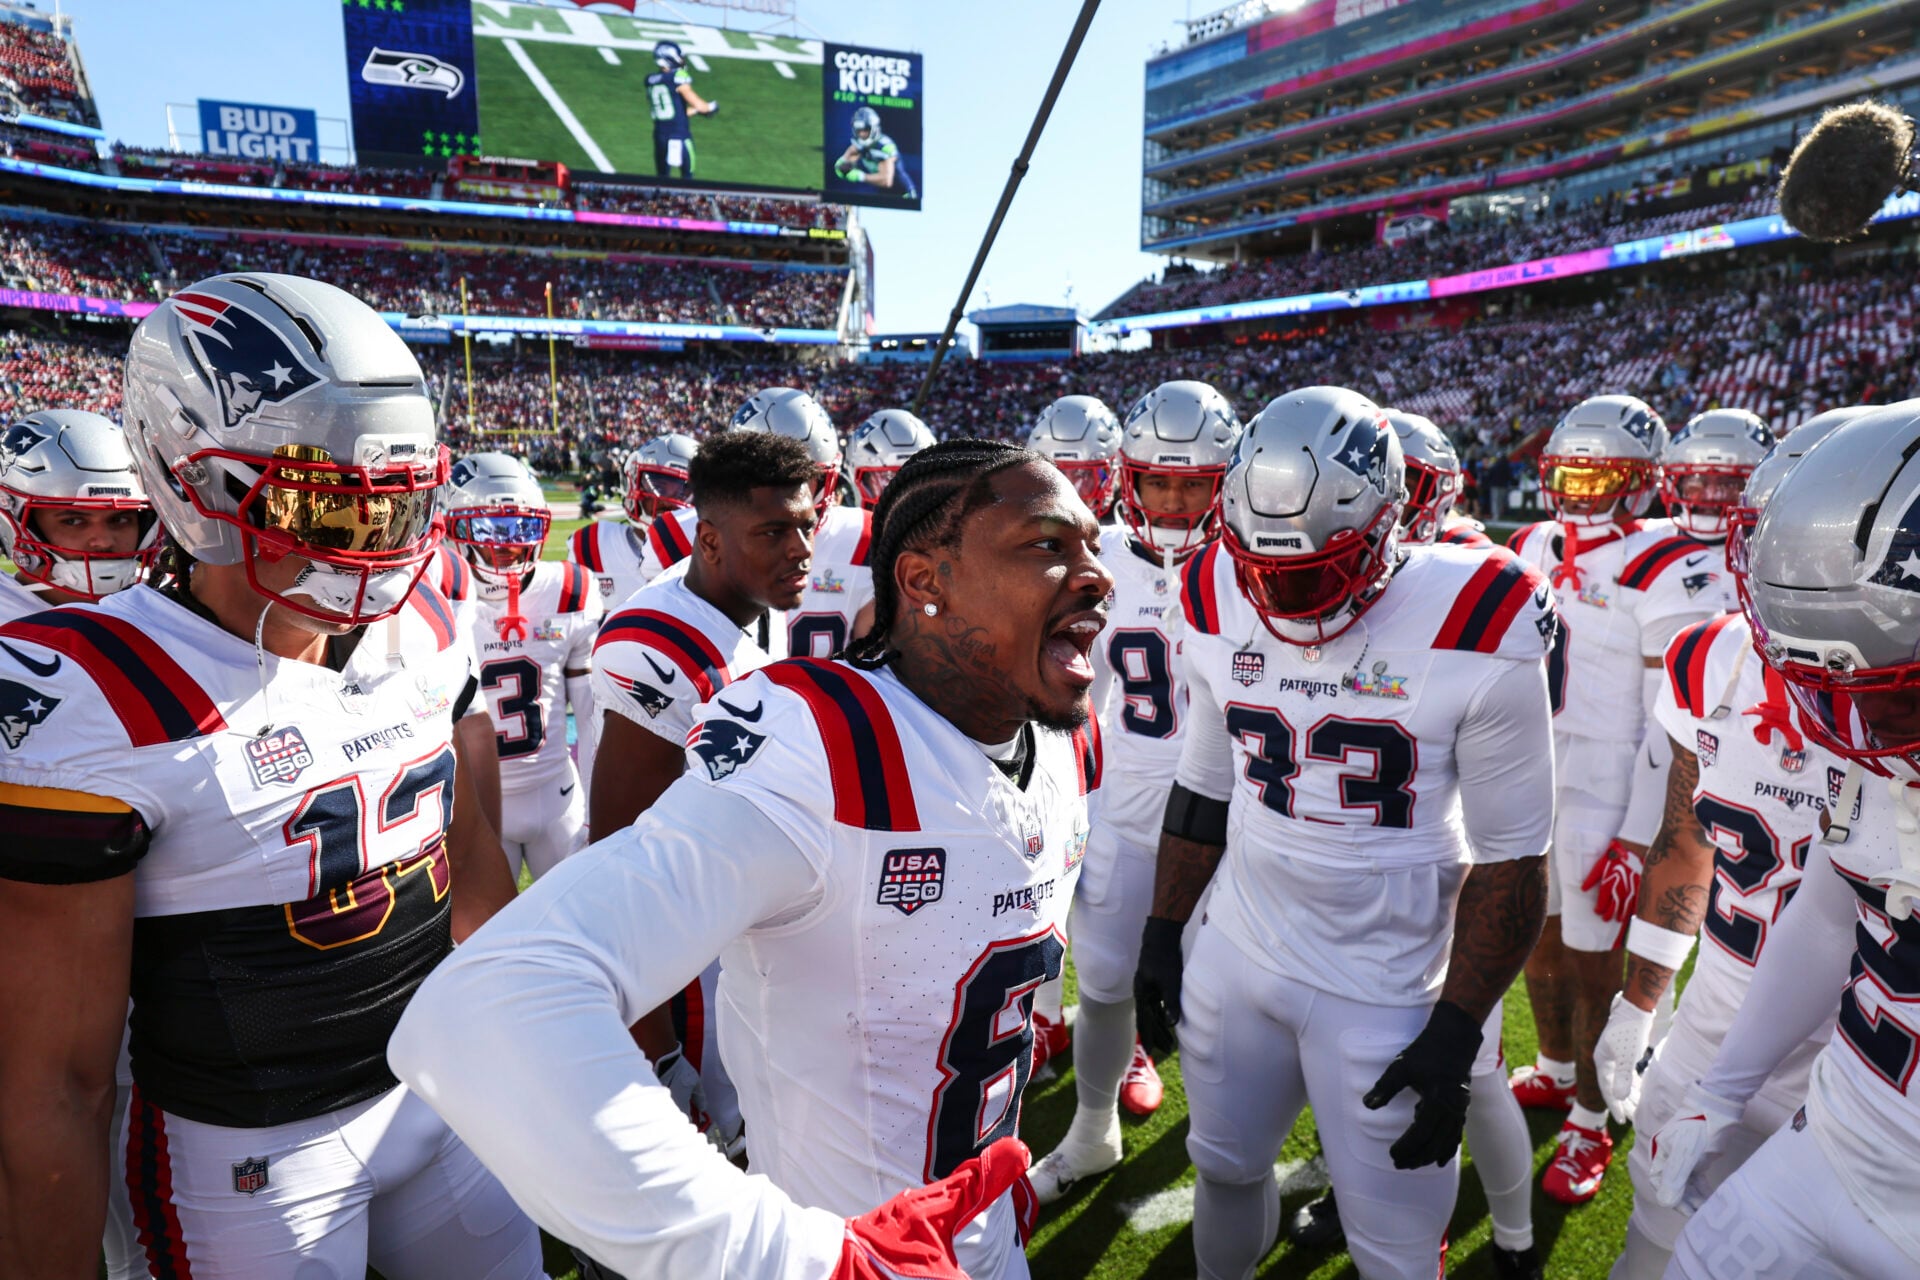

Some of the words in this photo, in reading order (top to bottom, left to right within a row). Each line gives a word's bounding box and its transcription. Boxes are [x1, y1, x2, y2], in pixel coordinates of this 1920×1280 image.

[834, 51, 911, 78] COOPER
[839, 69, 908, 97] KUPP
[219, 106, 297, 136] BUD
[207, 130, 312, 163] LIGHT
[1522, 262, 1557, 279] LX
[39, 293, 71, 310] BOWL
[78, 298, 125, 315] LX
[464, 317, 583, 333] SEAHAWKS
[625, 323, 724, 339] PATRIOTS
[1158, 455, 1191, 465] PATRIOTS
[88, 486, 131, 497] PATRIOTS
[1256, 536, 1302, 549] PATRIOTS
[1138, 606, 1166, 616] PATRI
[484, 639, 523, 653] PATRIOTS
[1304, 650, 1320, 661] NFL
[1234, 654, 1262, 666] USA
[1106, 627, 1183, 740] 9
[1232, 670, 1263, 681] 250
[1279, 677, 1338, 698] PATRIOTS
[480, 655, 547, 761] 3
[249, 732, 302, 757] USA
[341, 722, 415, 763] PATRIOTS
[1698, 731, 1716, 748] USA
[257, 751, 312, 784] 250
[1782, 756, 1801, 770] NFL
[1754, 781, 1826, 811] PATRIOTS
[1027, 835, 1042, 854] NFL
[889, 854, 941, 872] USA
[1692, 790, 1813, 968] 2
[879, 882, 941, 903] 250
[992, 879, 1055, 918] PATRIOTS
[239, 1172, 265, 1190] NFL
